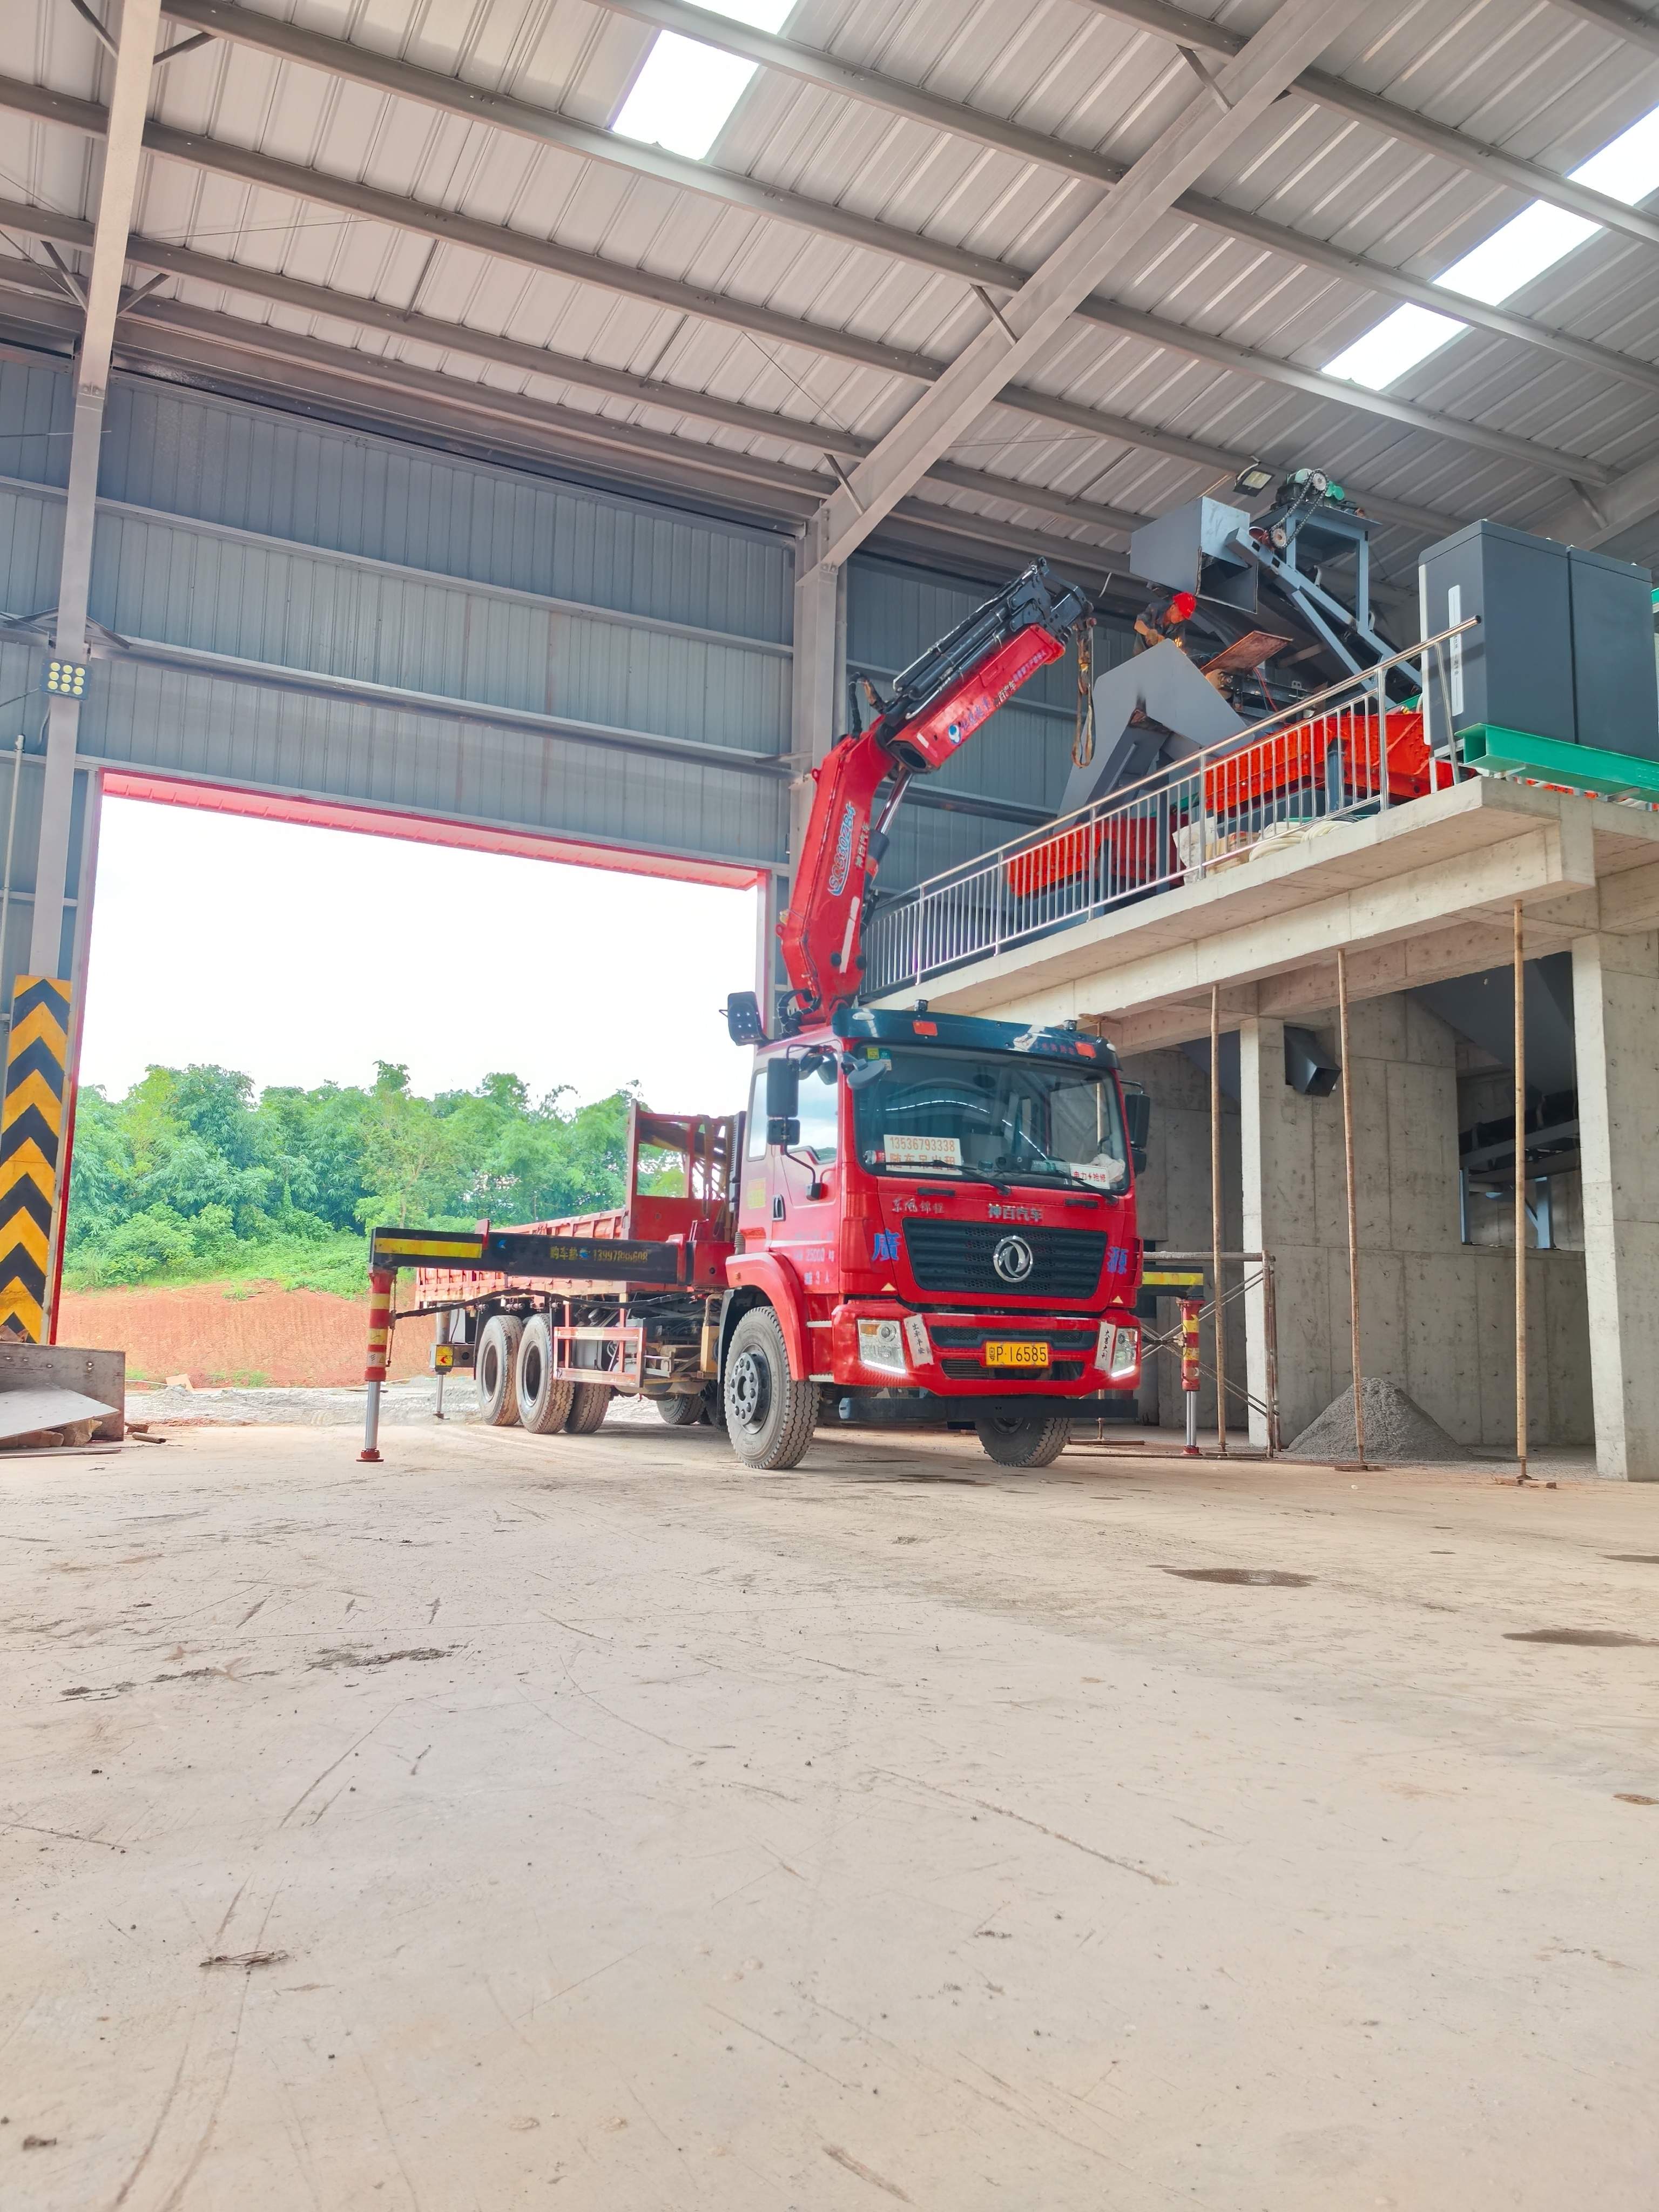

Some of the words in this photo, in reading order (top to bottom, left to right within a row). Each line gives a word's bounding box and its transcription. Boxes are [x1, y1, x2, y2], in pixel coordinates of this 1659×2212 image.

[889, 1136, 955, 1152] 13536793338
[988, 1203, 1043, 1222] 神百汽车
[871, 1228, 902, 1262] 廣
